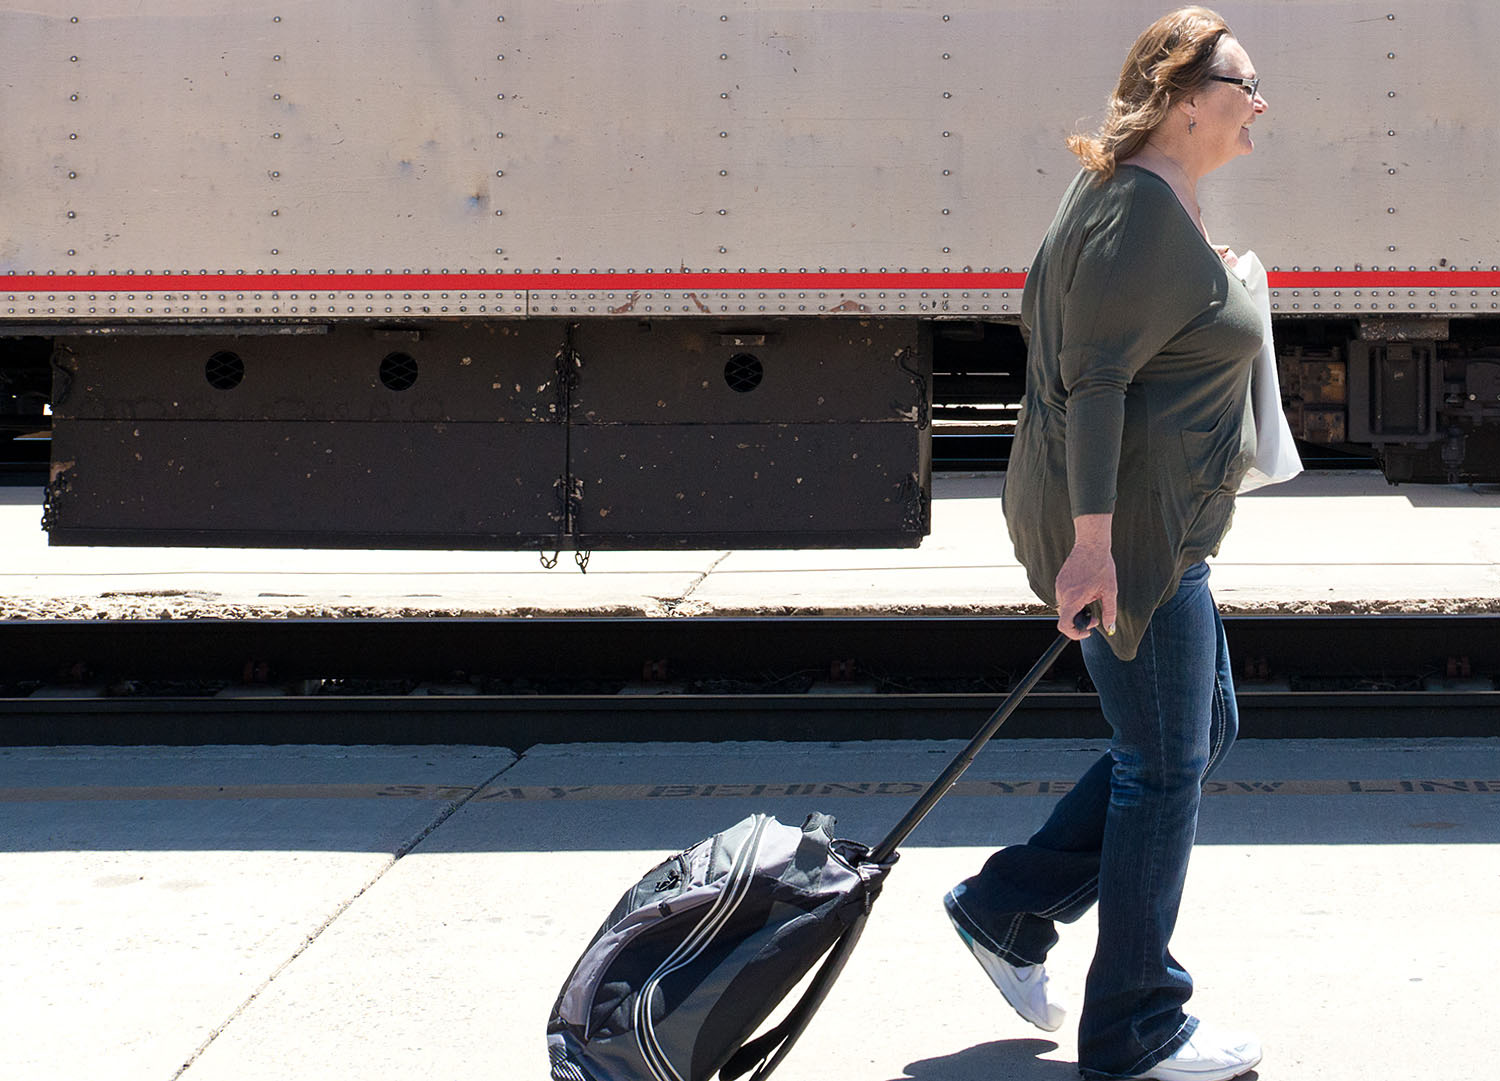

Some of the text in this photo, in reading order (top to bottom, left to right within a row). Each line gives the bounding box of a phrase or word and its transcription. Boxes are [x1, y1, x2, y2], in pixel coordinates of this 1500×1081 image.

[376, 785, 590, 799] STAY
[646, 783, 924, 797] BEHIND
[989, 781, 1284, 794] YEOW
